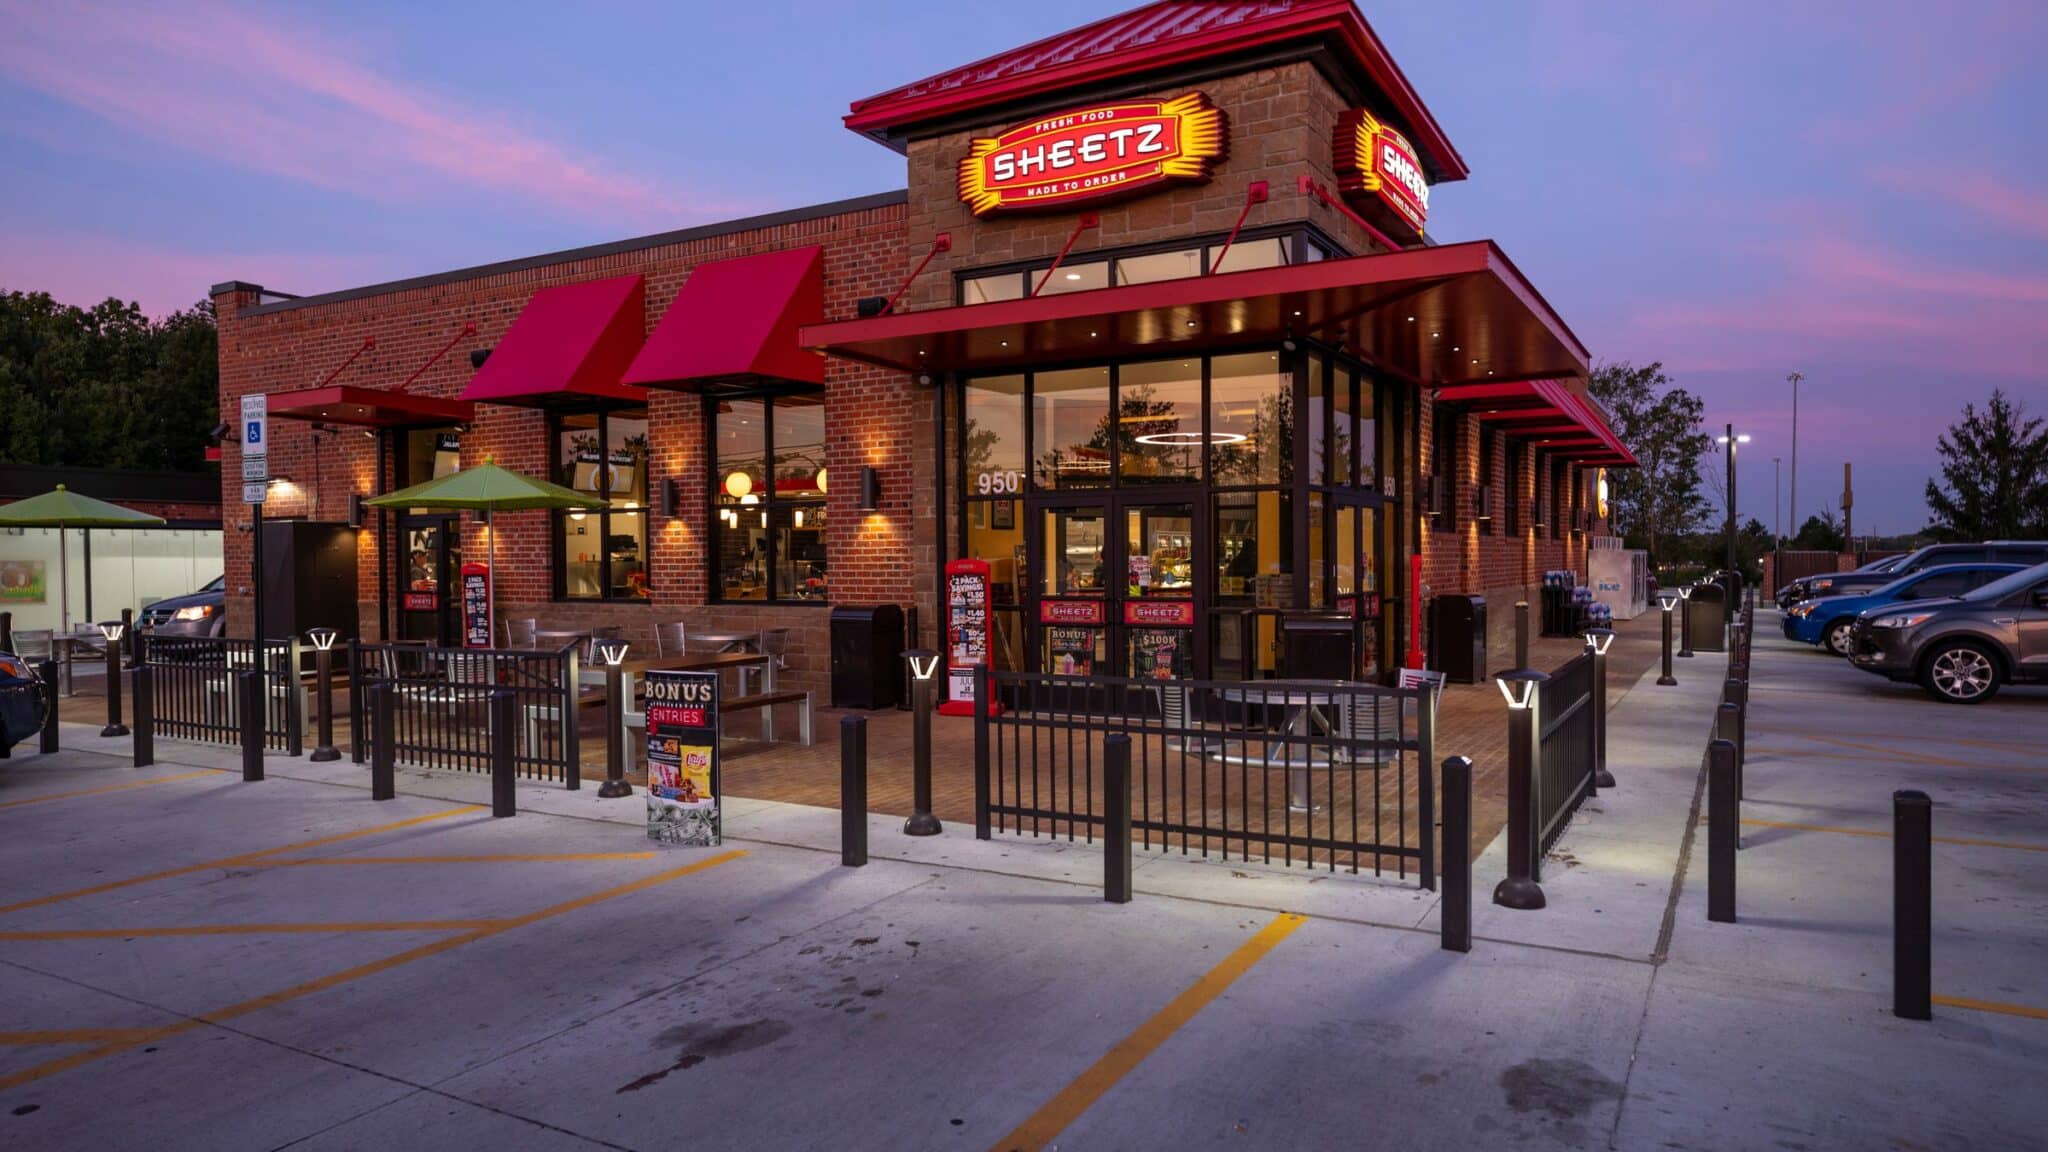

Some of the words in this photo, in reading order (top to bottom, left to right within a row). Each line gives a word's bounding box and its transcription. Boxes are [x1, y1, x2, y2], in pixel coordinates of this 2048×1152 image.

[1035, 117, 1073, 133] FRESH
[1081, 110, 1114, 122] FOOD
[993, 123, 1163, 181] SHEETZ
[1027, 185, 1058, 197] MADE
[1063, 182, 1079, 191] TO
[1084, 172, 1126, 187] ORDER
[978, 470, 1018, 495] 950
[1052, 630, 1087, 640] BONUS
[1143, 634, 1176, 646] $100K
[645, 681, 712, 701] BONUS
[653, 711, 699, 723] ENTRIES
